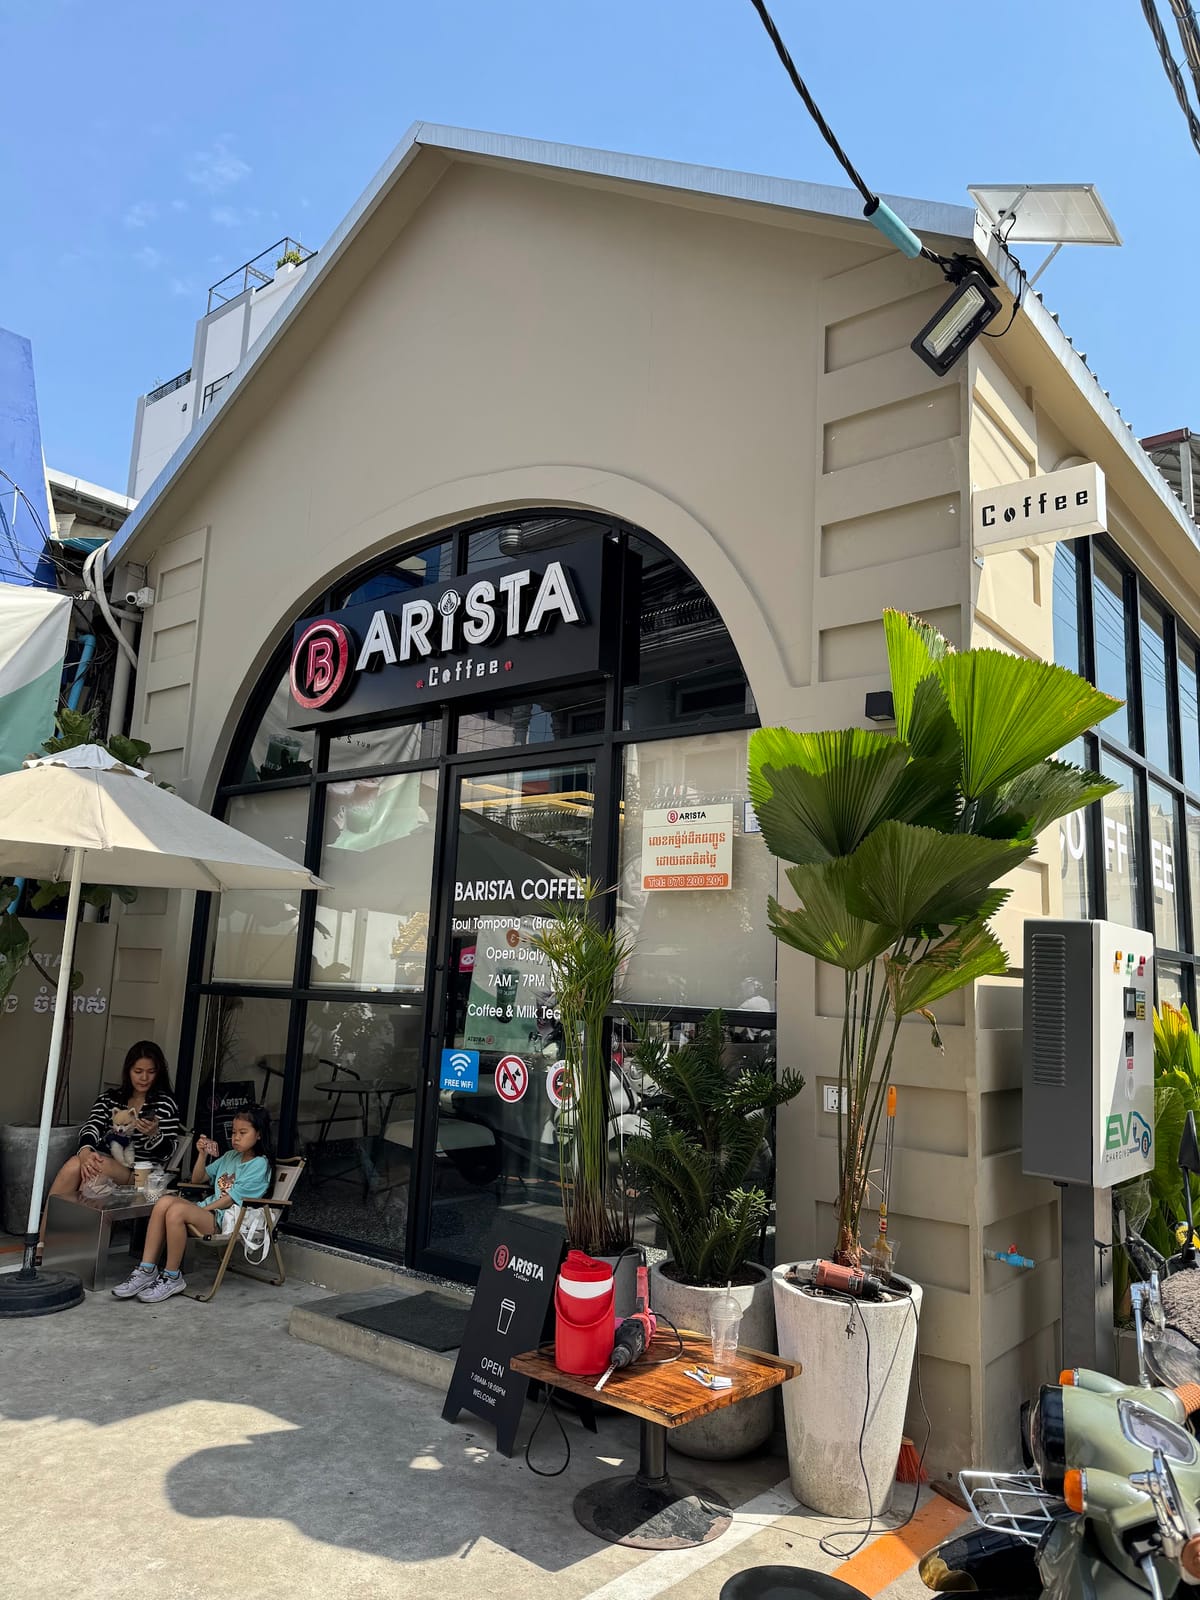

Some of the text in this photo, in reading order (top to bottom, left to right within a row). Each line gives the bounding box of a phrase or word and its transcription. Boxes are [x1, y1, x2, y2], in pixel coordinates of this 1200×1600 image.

[982, 490, 1088, 527] Coffee
[428, 659, 498, 687] Coffee
[687, 876, 704, 886] 200
[706, 875, 724, 886] 201
[455, 879, 587, 901] BARISTA COFFEE
[452, 918, 471, 930] Toul
[474, 918, 521, 933] Tompong
[486, 947, 546, 963] Open Dialy
[488, 975, 512, 987] 7AM
[522, 974, 545, 987] 7PM
[468, 1003, 503, 1017] Coffee
[506, 1004, 514, 1018] &
[517, 1005, 538, 1019] Milk
[444, 1078, 459, 1088] FREE
[1106, 1112, 1133, 1150] EV
[481, 1357, 505, 1378] OPEN
[472, 1388, 497, 1407] WELCOME
